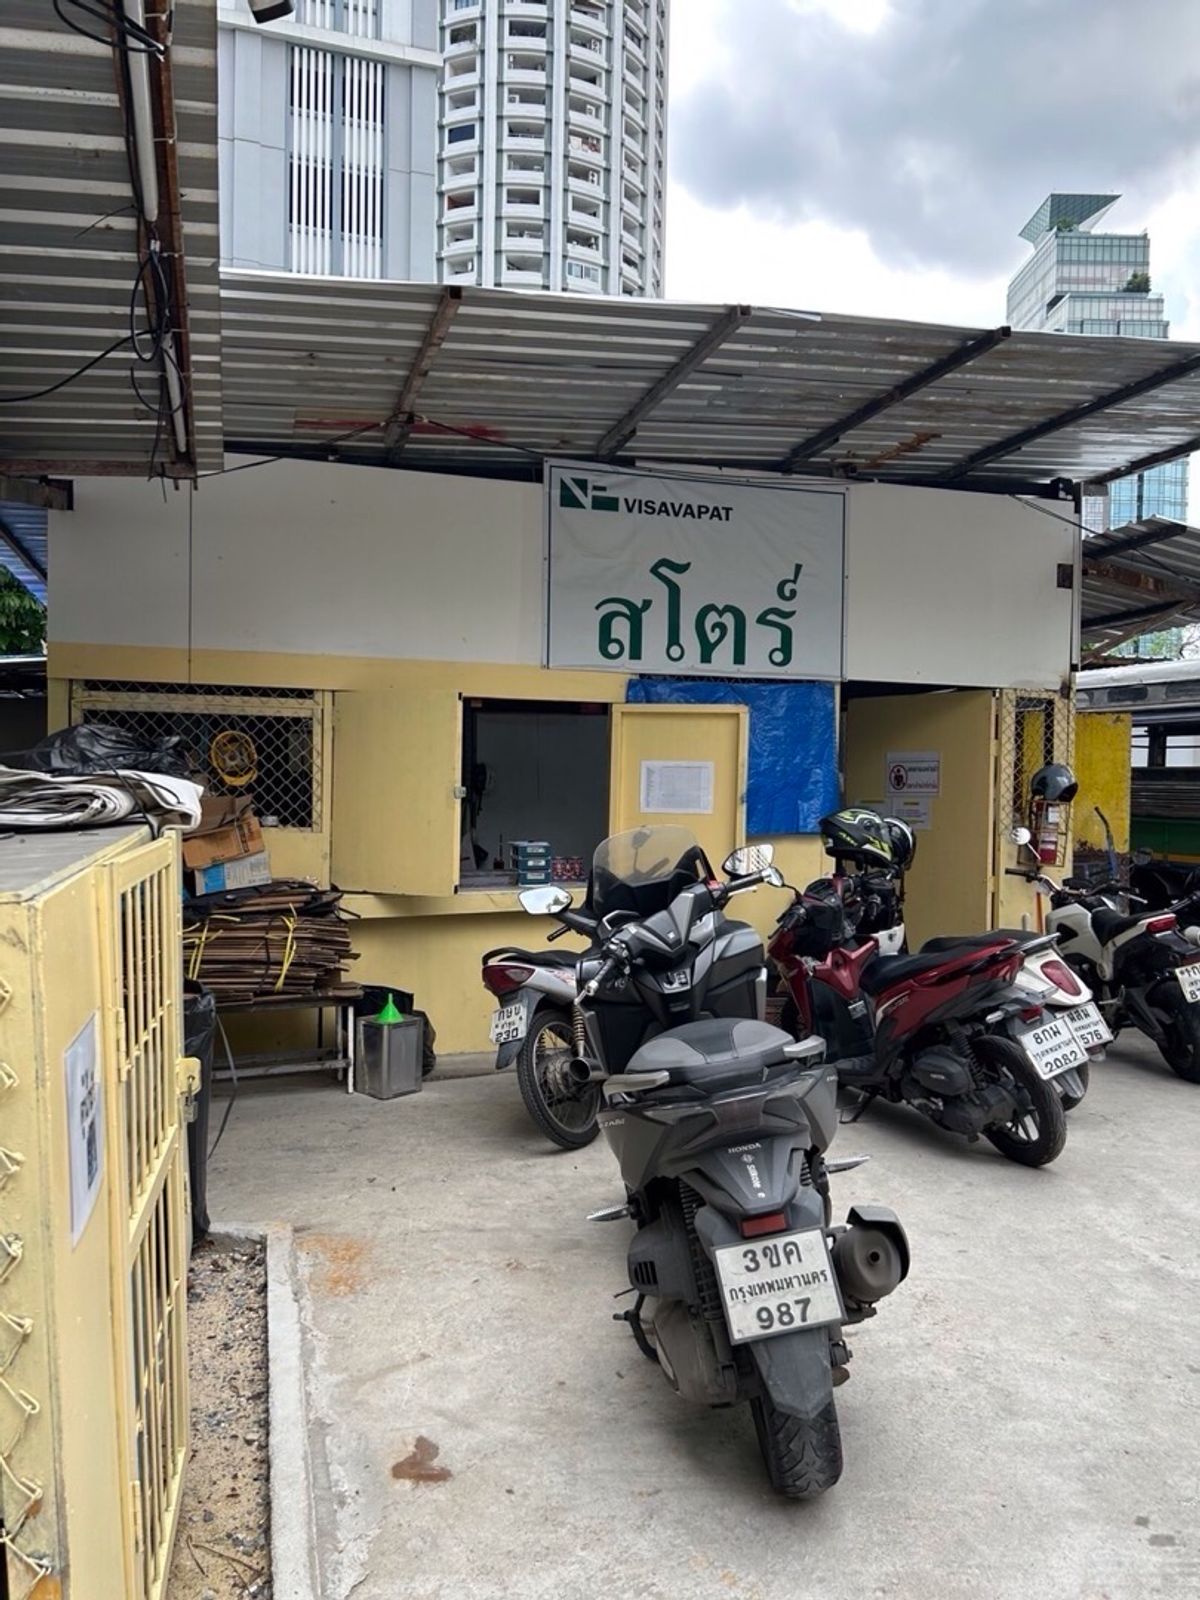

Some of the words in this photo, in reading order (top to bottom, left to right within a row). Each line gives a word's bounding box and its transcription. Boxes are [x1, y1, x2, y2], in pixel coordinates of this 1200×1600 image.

[624, 497, 734, 522] VISAVAPAT
[594, 557, 804, 668] สโตร์
[495, 1027, 519, 1043] 230
[1032, 1023, 1062, 1045] 8กม
[1080, 1029, 1103, 1045] 576
[1044, 1050, 1078, 1072] 2082
[727, 1141, 762, 1154] HONDA
[742, 1240, 803, 1272] 3ขค
[729, 1269, 829, 1303] กรุงเทพมหานคร
[755, 1296, 812, 1330] 987
